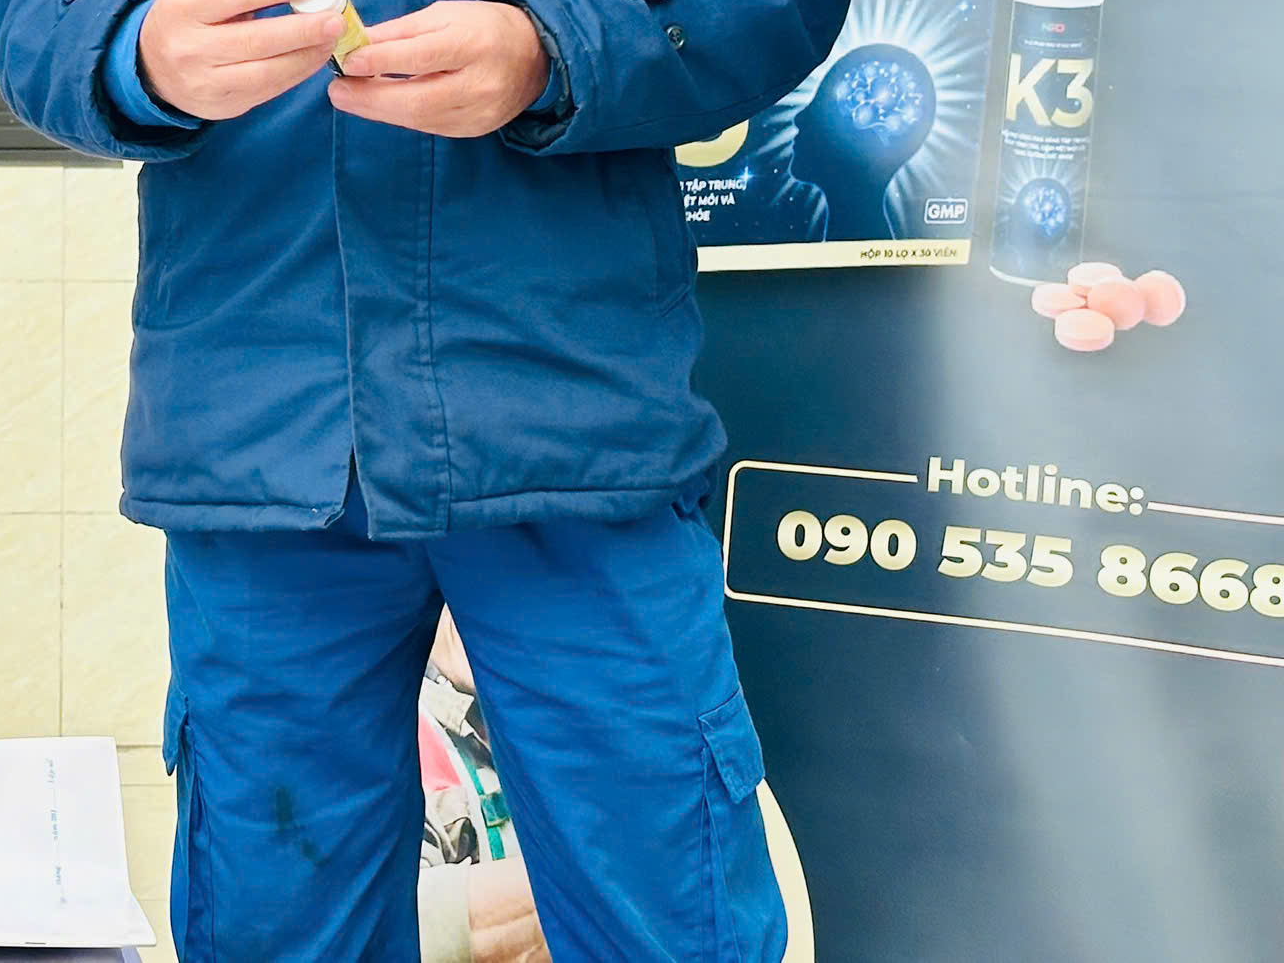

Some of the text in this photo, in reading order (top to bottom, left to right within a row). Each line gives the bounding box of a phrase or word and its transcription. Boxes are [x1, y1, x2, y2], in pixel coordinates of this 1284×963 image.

[1006, 52, 1094, 128] K3
[928, 203, 965, 219] GMP
[926, 456, 1146, 517] Hotline:
[777, 510, 1284, 618] 090 535 8668
